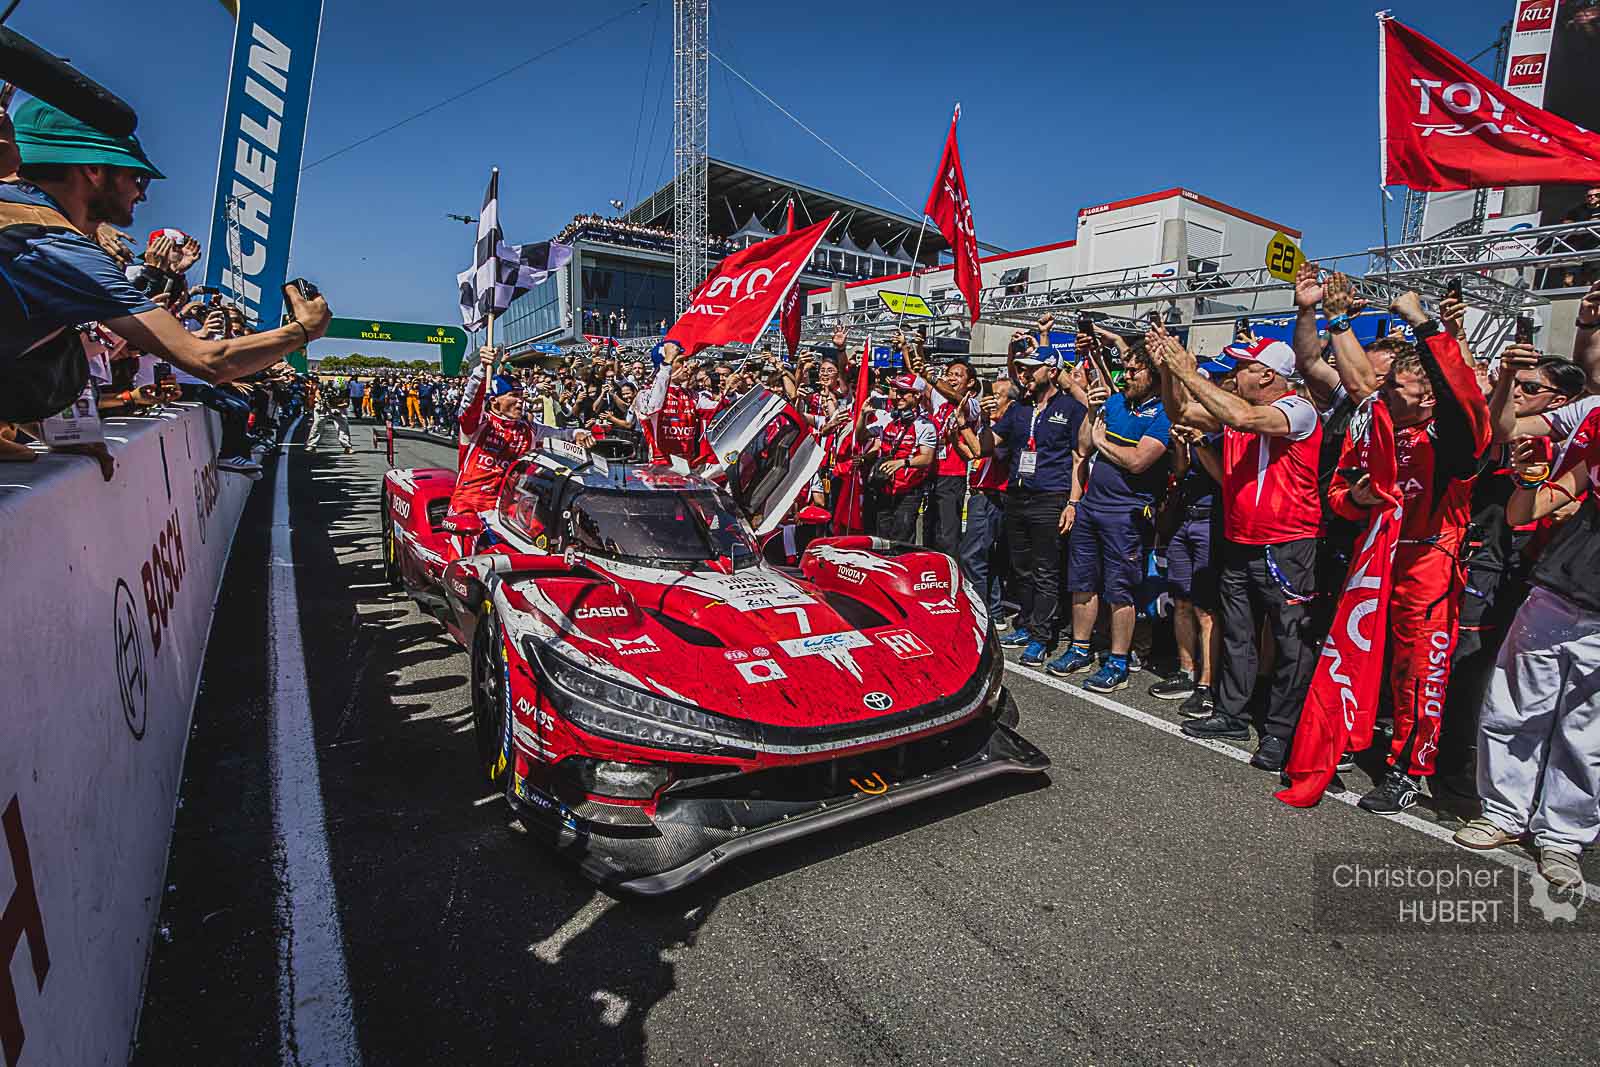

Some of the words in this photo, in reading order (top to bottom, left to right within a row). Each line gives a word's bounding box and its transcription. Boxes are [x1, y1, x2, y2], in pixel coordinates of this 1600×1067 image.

[1521, 7, 1552, 21] RTL2
[1512, 62, 1543, 76] RTL2
[217, 22, 291, 327] ICHELIN
[1270, 242, 1295, 274] 28
[361, 331, 392, 340] ROLEX
[427, 335, 455, 344] ROLEX
[562, 442, 583, 455] TOYOTA
[393, 494, 410, 519] DENSO
[141, 507, 185, 657] BOSCH
[838, 565, 861, 580] TOYOTA
[859, 572, 867, 585] 7
[913, 581, 949, 591] EDIFICE
[575, 607, 629, 619] CASIO
[774, 607, 812, 634] 7
[803, 634, 846, 648] WEC
[881, 633, 922, 655] HY
[619, 647, 661, 656] MARELLI
[1424, 631, 1450, 718] DENSO
